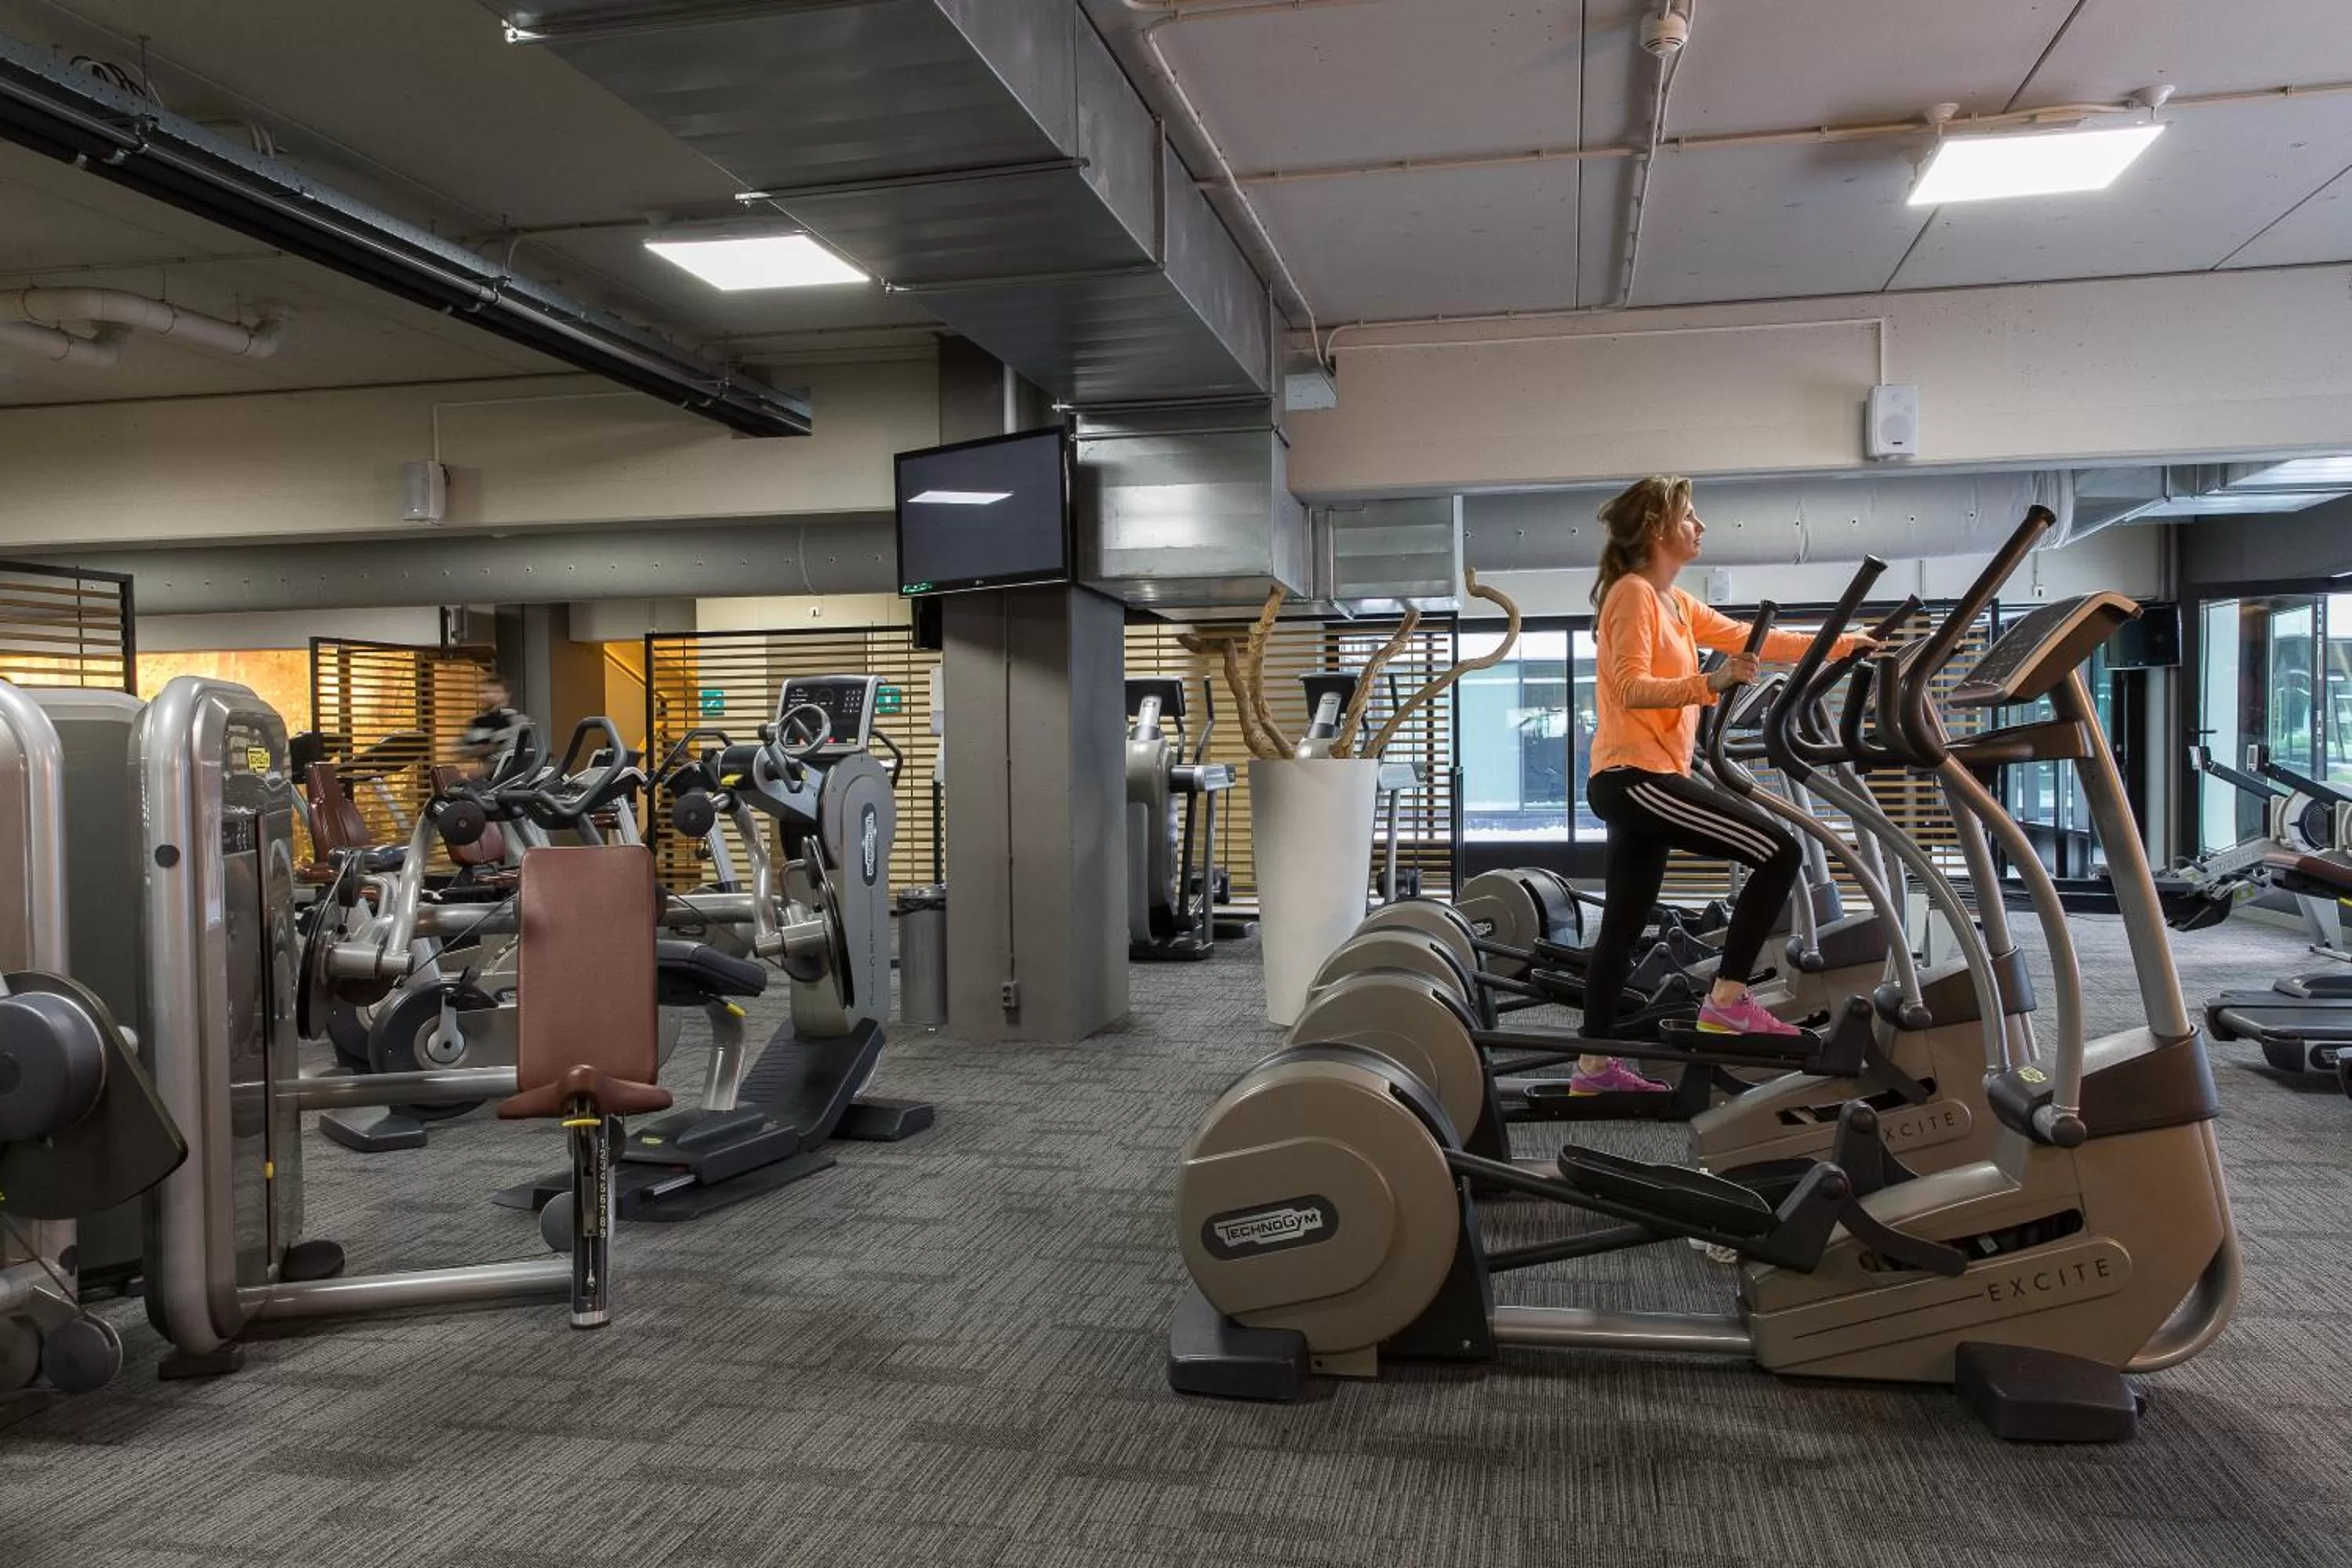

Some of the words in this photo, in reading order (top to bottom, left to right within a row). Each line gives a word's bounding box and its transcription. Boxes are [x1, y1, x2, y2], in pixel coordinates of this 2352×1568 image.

[1883, 1111, 1955, 1143] XCITE
[1216, 1211, 1320, 1243] TECHNOGYM
[1987, 1258, 2111, 1302] EXCITE
